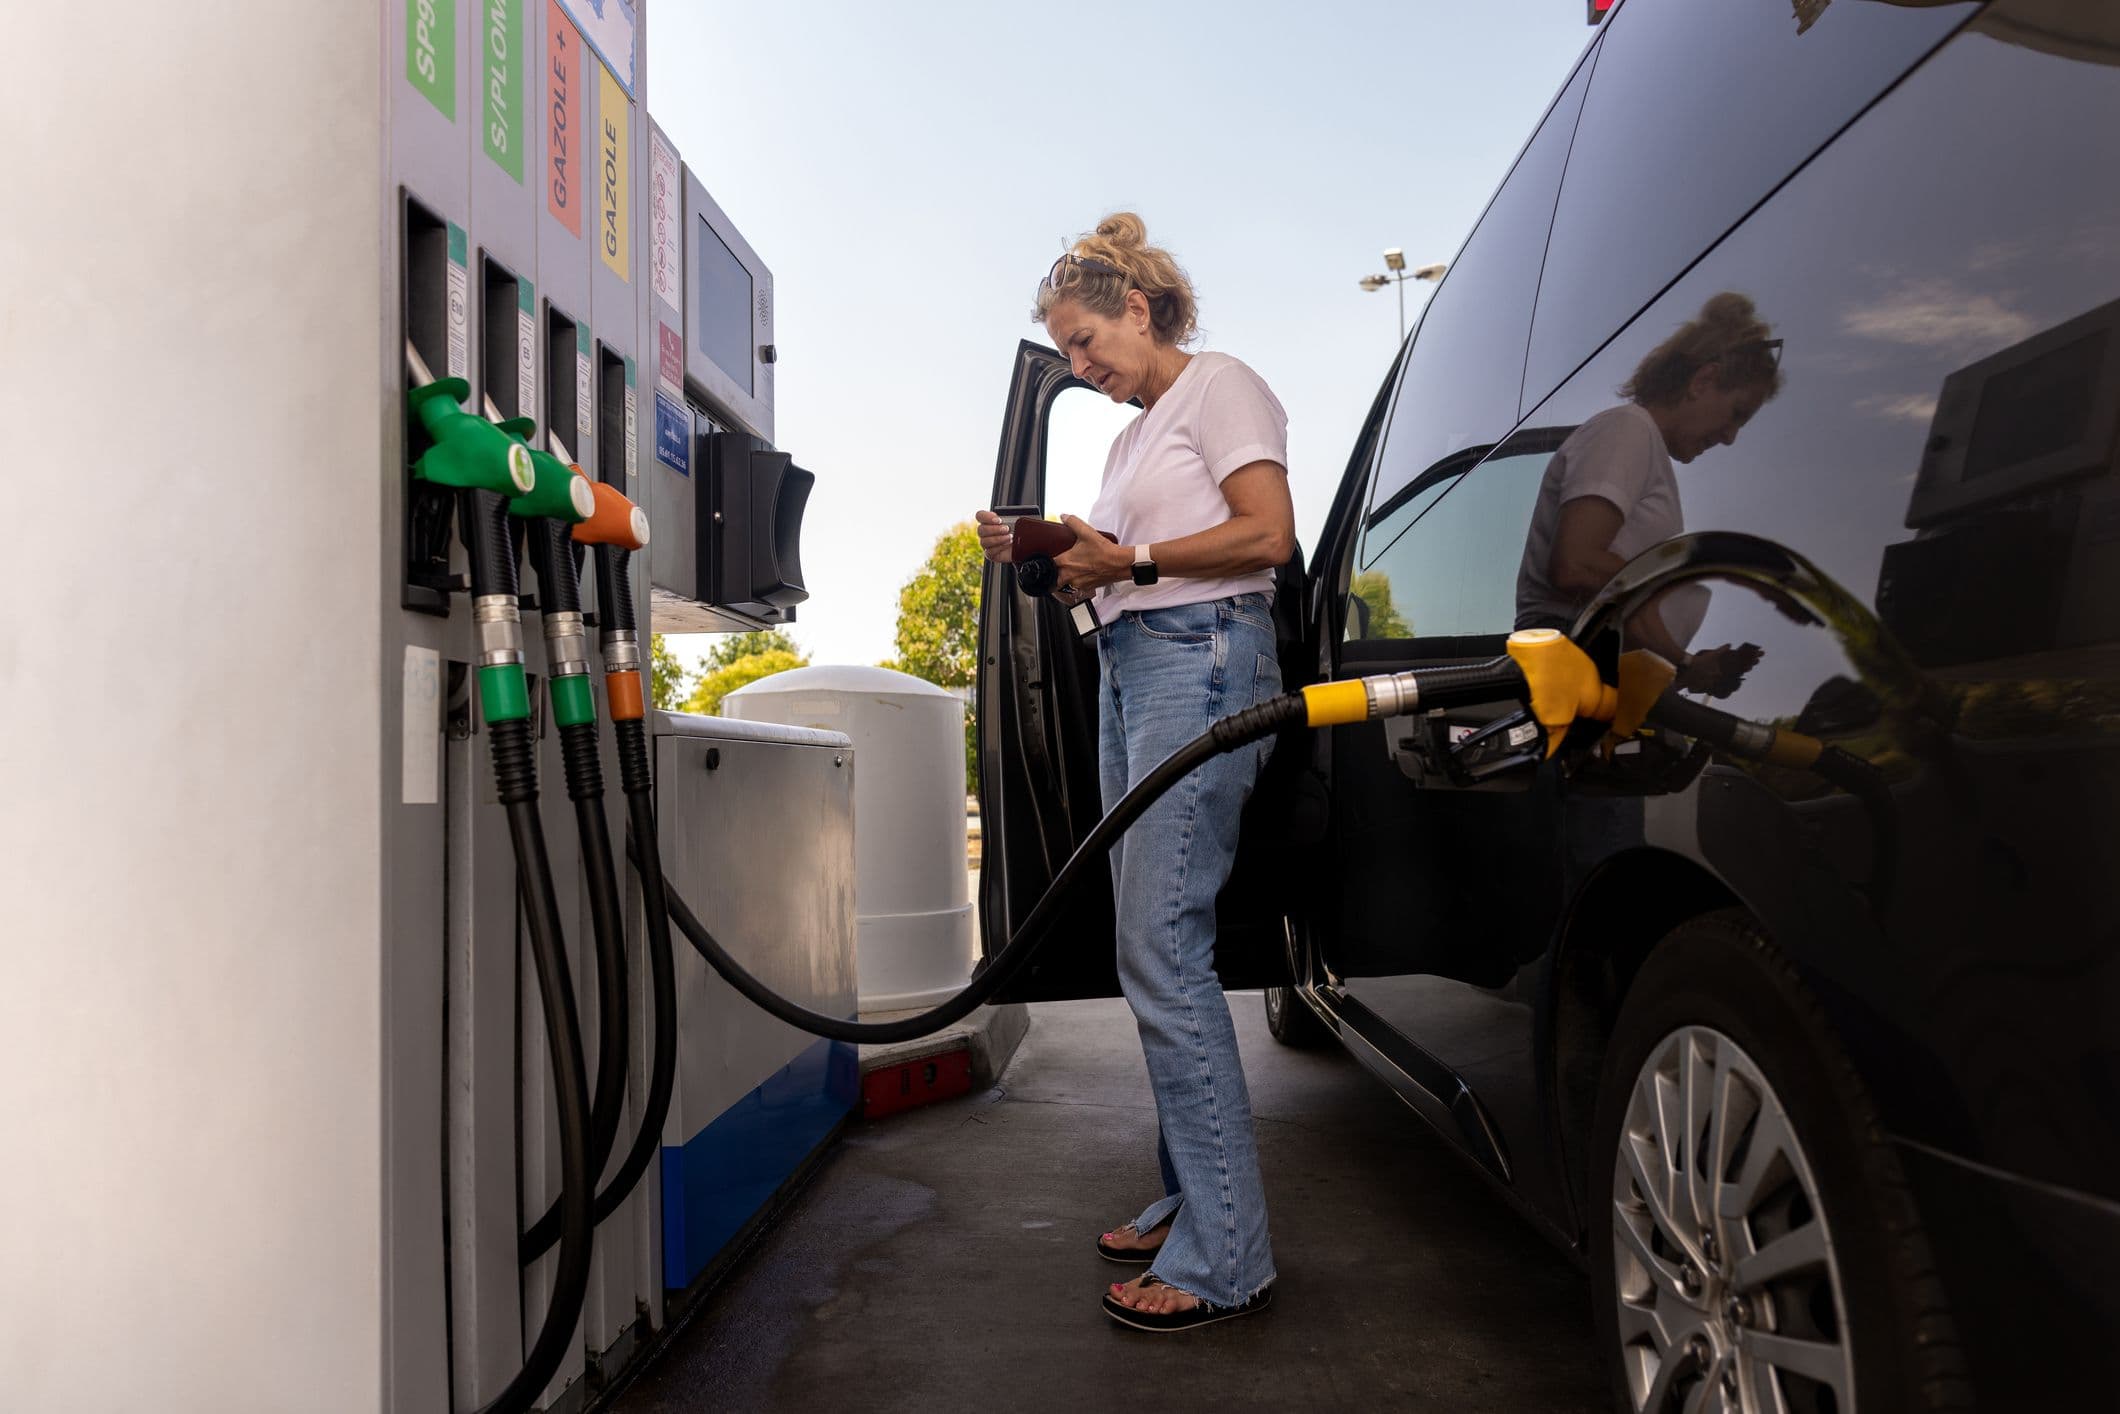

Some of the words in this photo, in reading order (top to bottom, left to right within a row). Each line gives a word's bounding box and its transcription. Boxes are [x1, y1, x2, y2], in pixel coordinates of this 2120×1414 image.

[416, 0, 436, 84] SP9
[553, 55, 567, 209] GAZOLE
[605, 118, 617, 257] GAZOLE
